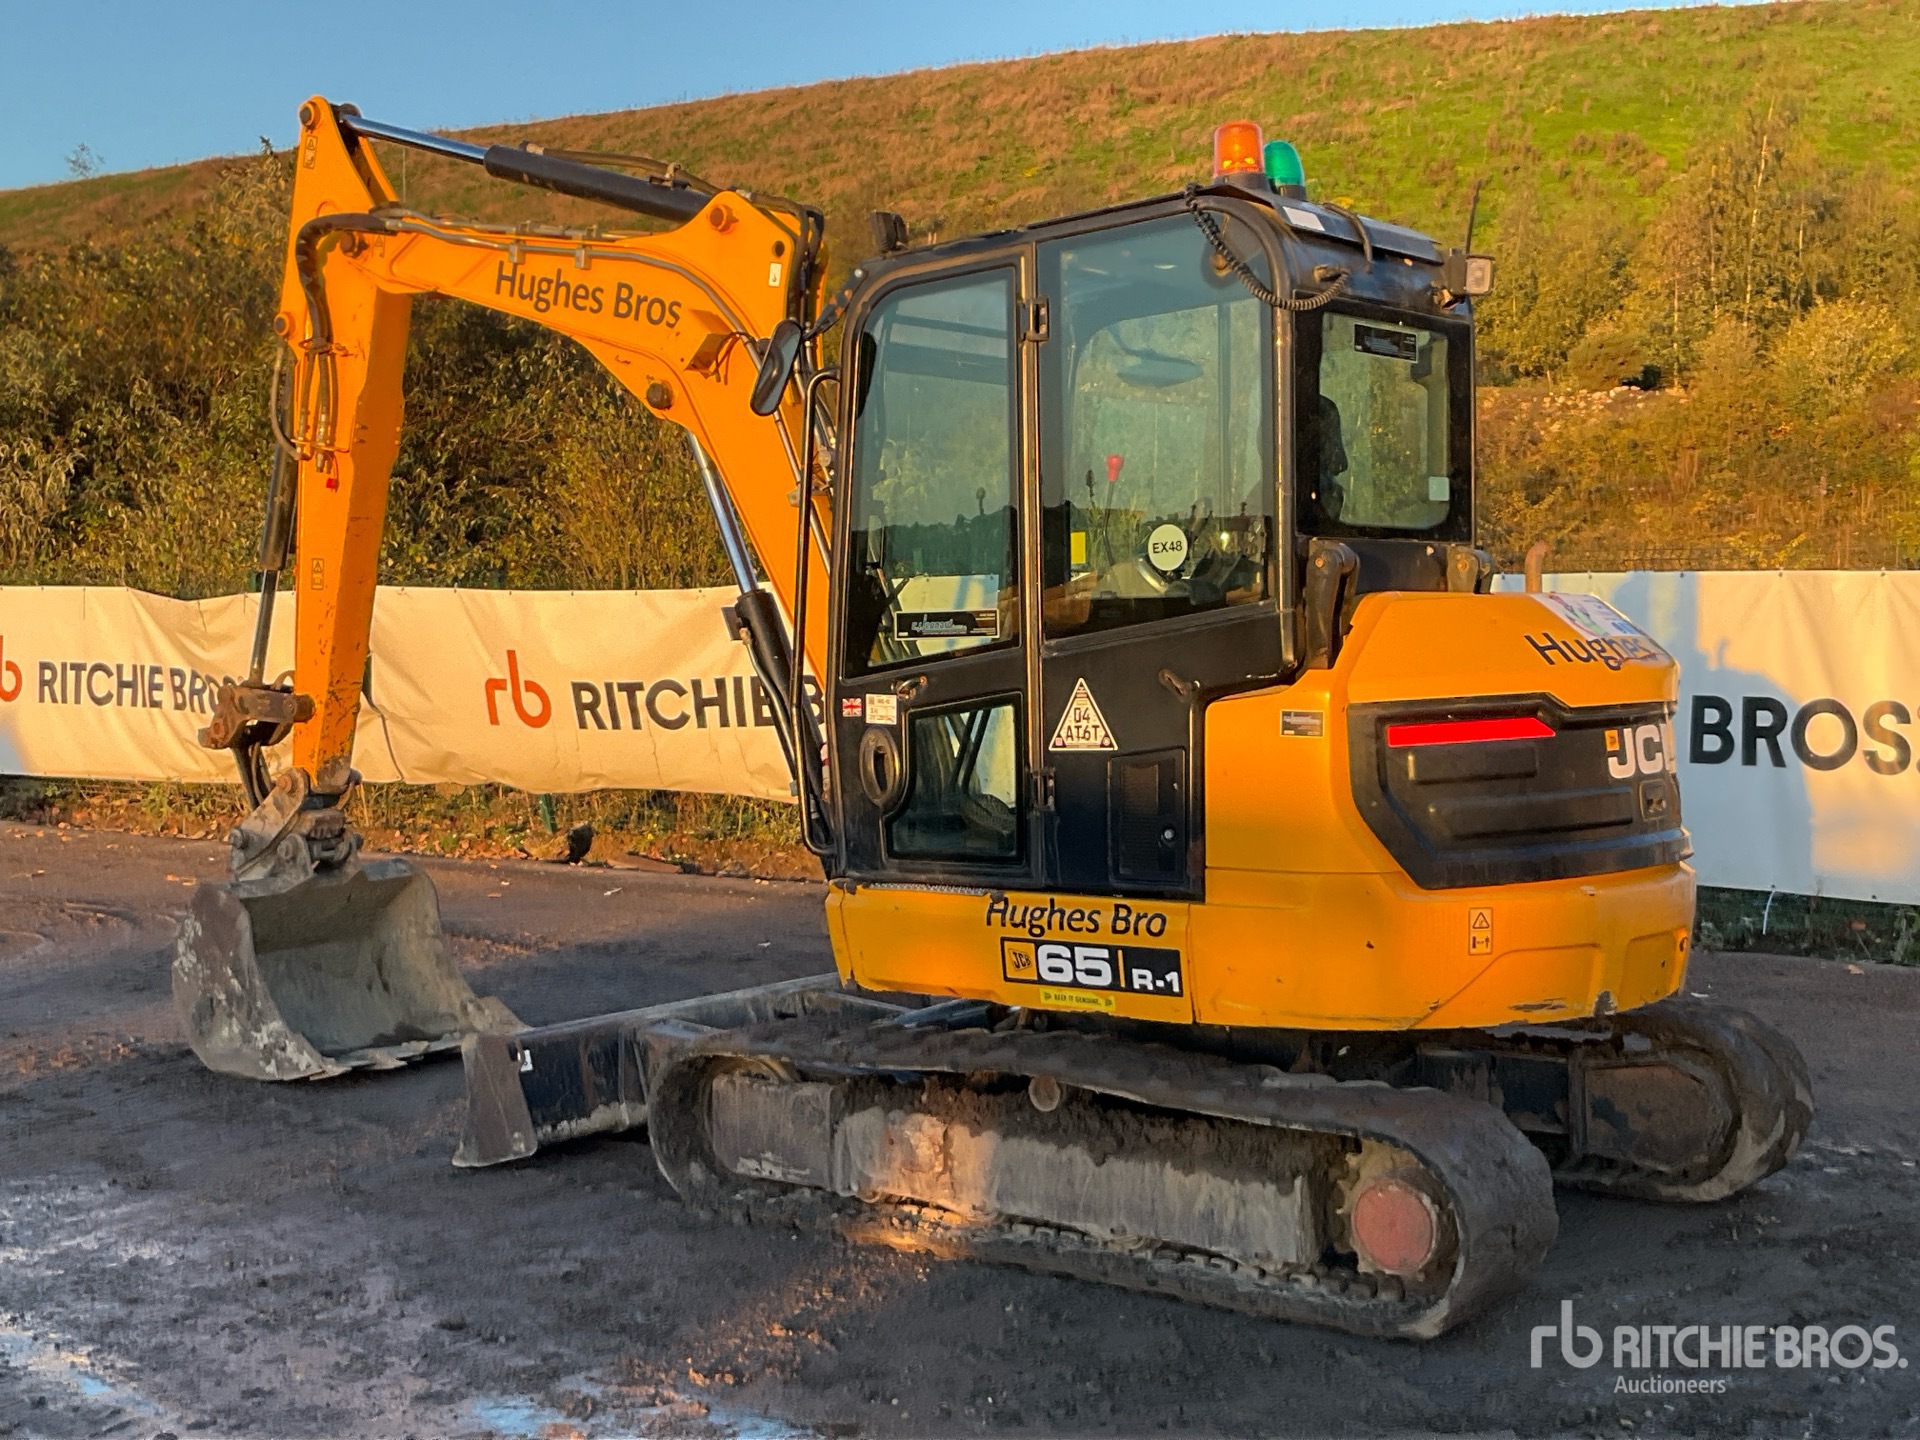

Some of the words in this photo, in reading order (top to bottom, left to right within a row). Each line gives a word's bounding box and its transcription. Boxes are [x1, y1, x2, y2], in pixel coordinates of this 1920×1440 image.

[495, 260, 604, 313] Hughes
[613, 281, 682, 329] Bros
[1152, 540, 1183, 554] EX48
[38, 660, 165, 710] RITCHIE
[169, 667, 237, 715] BRO
[485, 649, 552, 729] rb
[986, 897, 1101, 937] Hughes
[1111, 903, 1167, 938] Bro
[1012, 950, 1032, 969] JCB
[1037, 943, 1113, 987] 65
[1131, 968, 1181, 993] R-1
